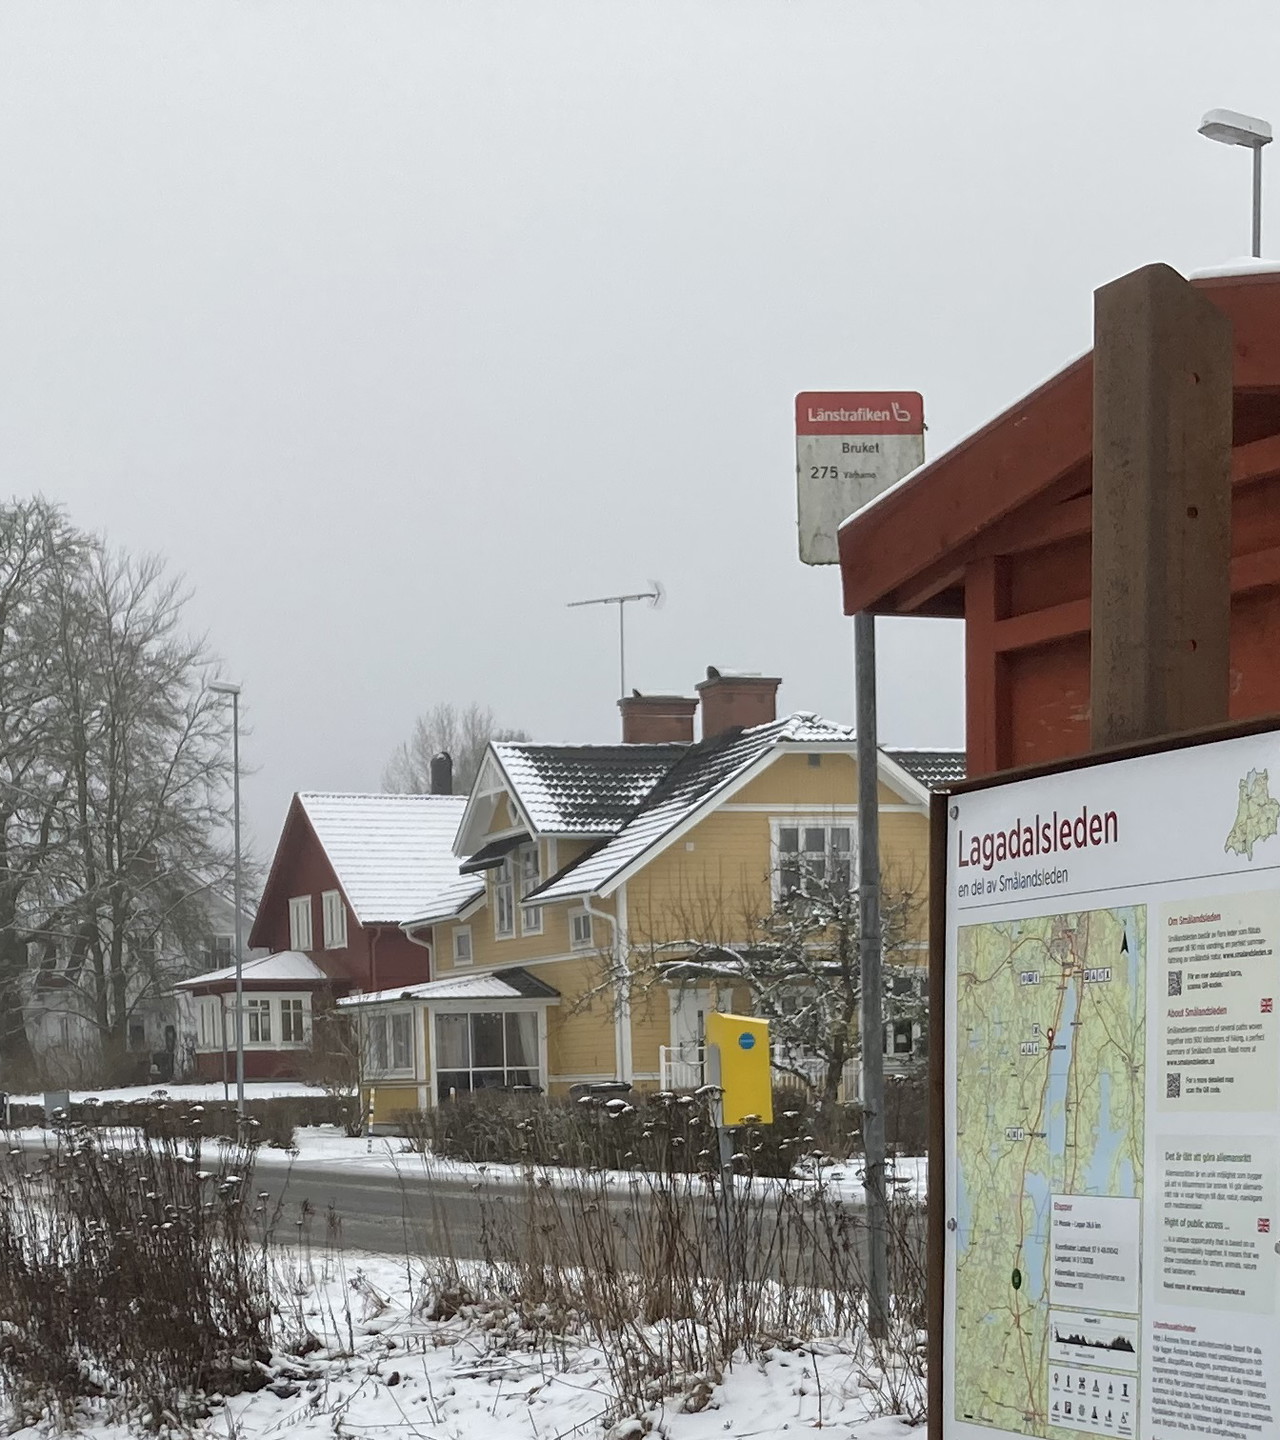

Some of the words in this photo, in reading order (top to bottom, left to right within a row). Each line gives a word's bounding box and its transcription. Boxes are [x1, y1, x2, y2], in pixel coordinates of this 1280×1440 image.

[808, 408, 890, 422] Länstrafiken
[842, 443, 879, 453] Bruket
[811, 466, 838, 479] 275
[958, 805, 1118, 870] Lagadalsleden
[958, 883, 969, 897] en
[971, 877, 985, 896] del
[986, 879, 998, 893] av
[999, 866, 1069, 892] Smålandsleden
[1168, 916, 1178, 926] Om
[1164, 1217, 1179, 1228] Right
[1180, 1217, 1186, 1226] of
[1187, 1218, 1204, 1228] public
